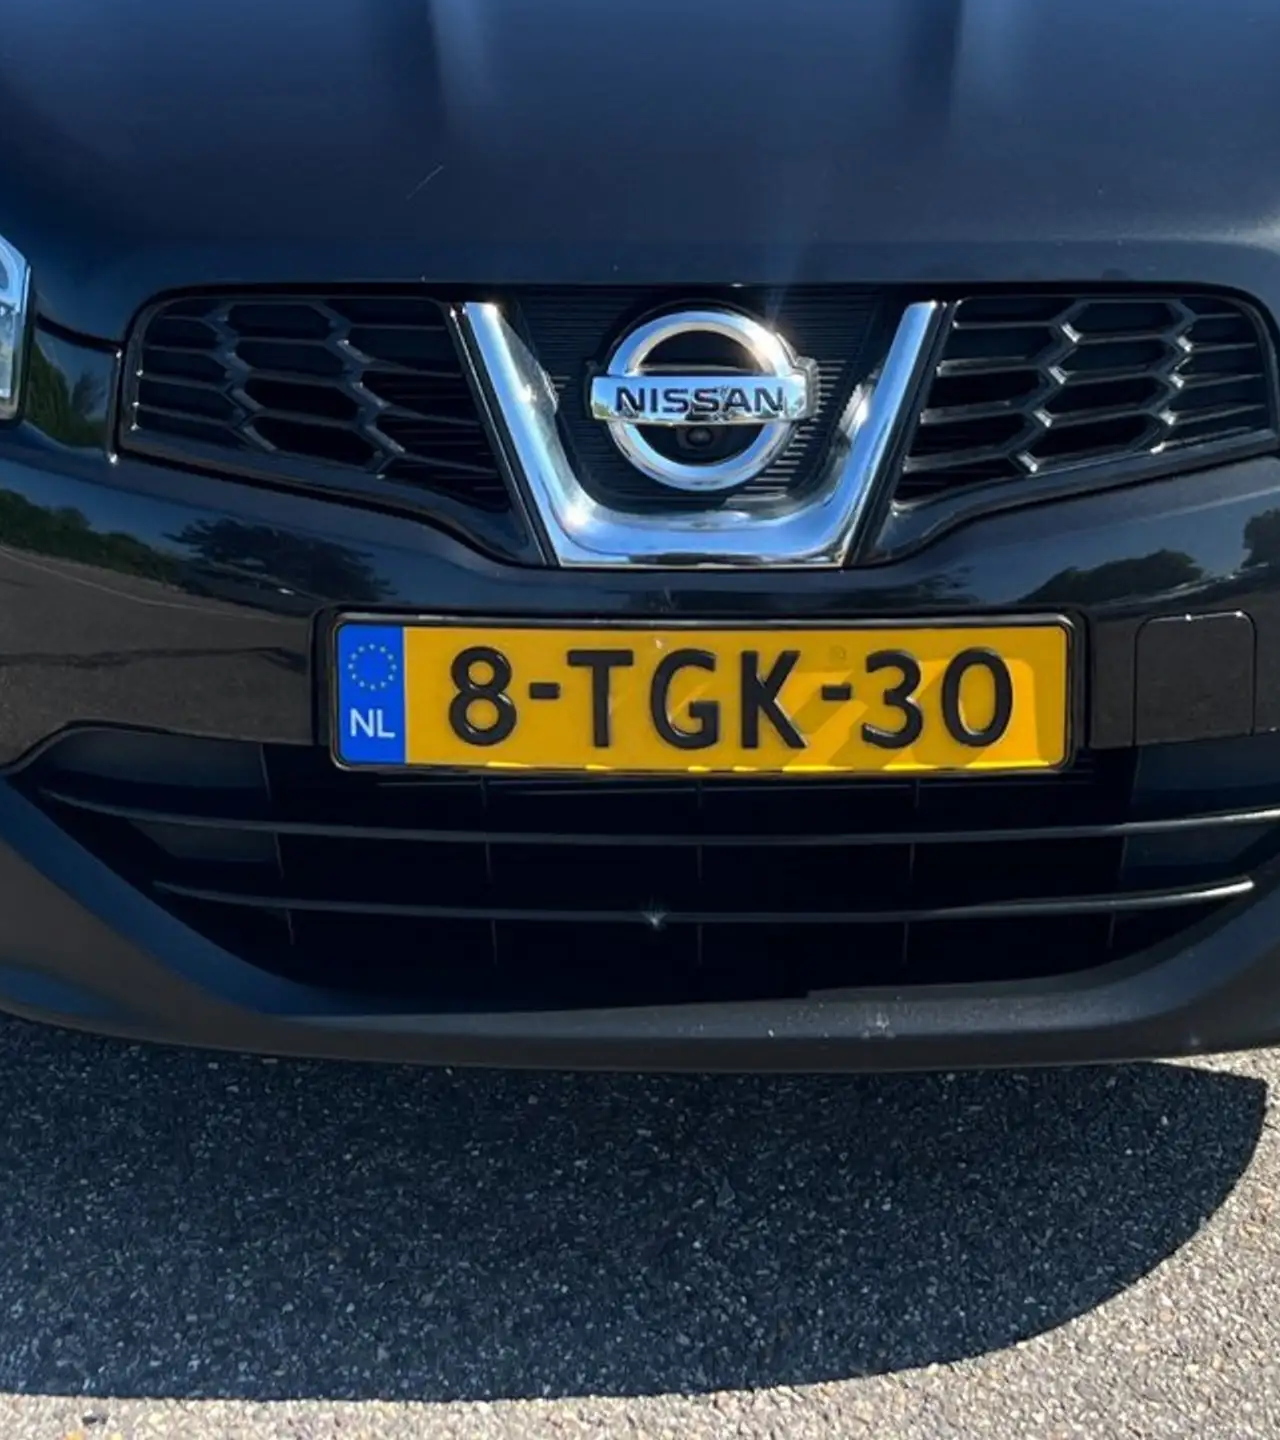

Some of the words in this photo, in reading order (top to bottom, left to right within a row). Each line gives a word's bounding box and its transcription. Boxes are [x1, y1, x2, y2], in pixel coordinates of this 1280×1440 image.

[615, 385, 785, 416] NISSAN
[448, 646, 1014, 748] 8-TGK-30
[350, 707, 397, 739] NL
